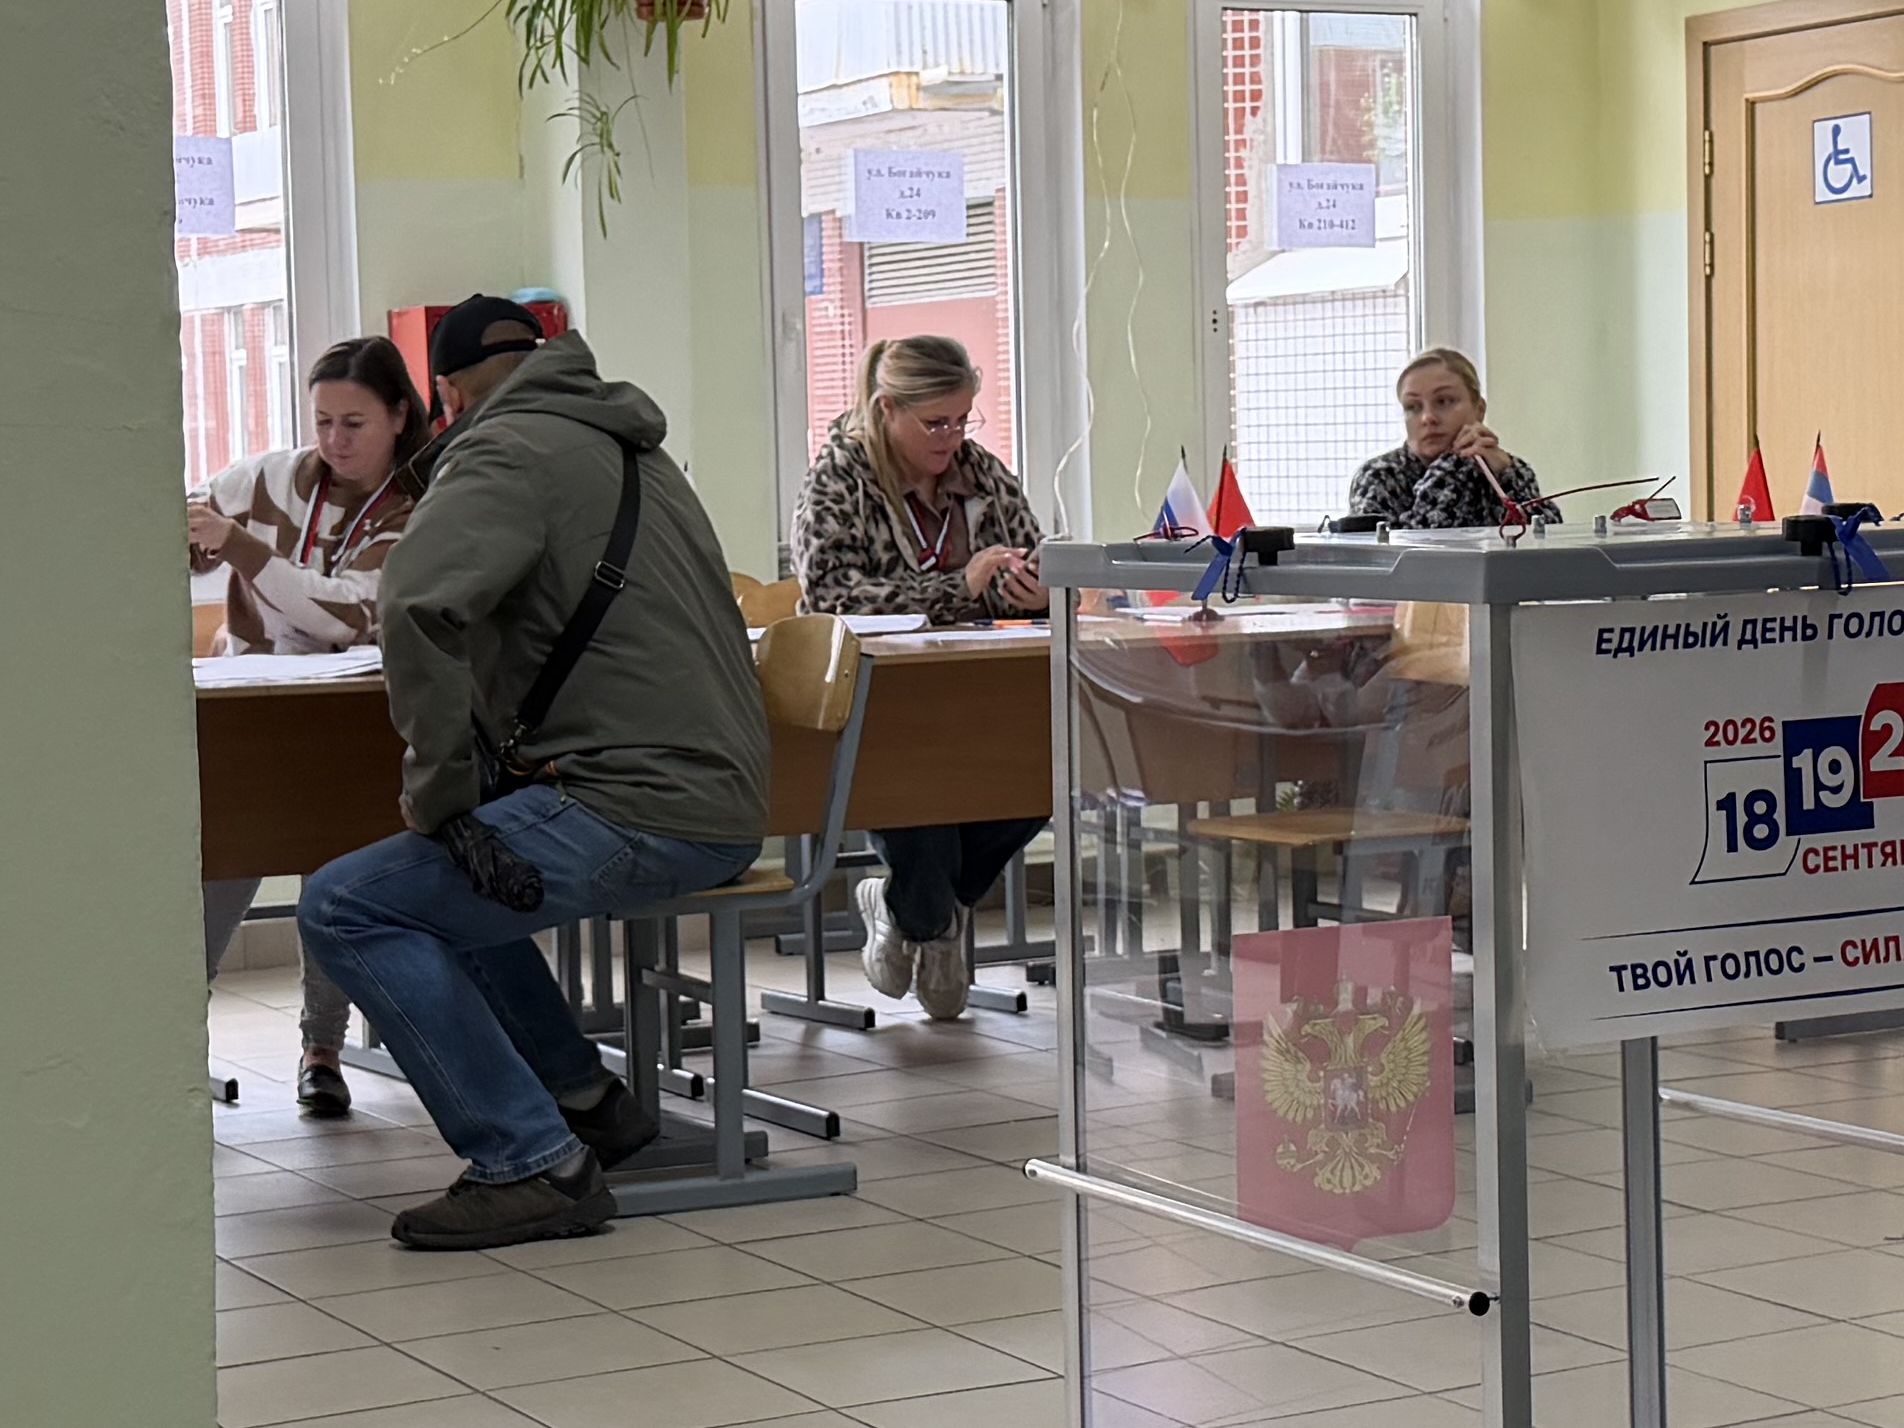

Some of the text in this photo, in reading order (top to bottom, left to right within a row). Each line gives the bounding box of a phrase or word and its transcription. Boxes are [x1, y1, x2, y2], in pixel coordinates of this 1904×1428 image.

[1595, 612, 1731, 659] ЕДИНЫЙ
[1737, 613, 1819, 652] ДЕНЬ
[1703, 715, 1777, 748] 2026
[1791, 745, 1855, 811] 19
[1715, 788, 1780, 855] 18
[1609, 948, 1698, 994] ТВОЙ
[1704, 944, 1806, 983] ГОЛОС
